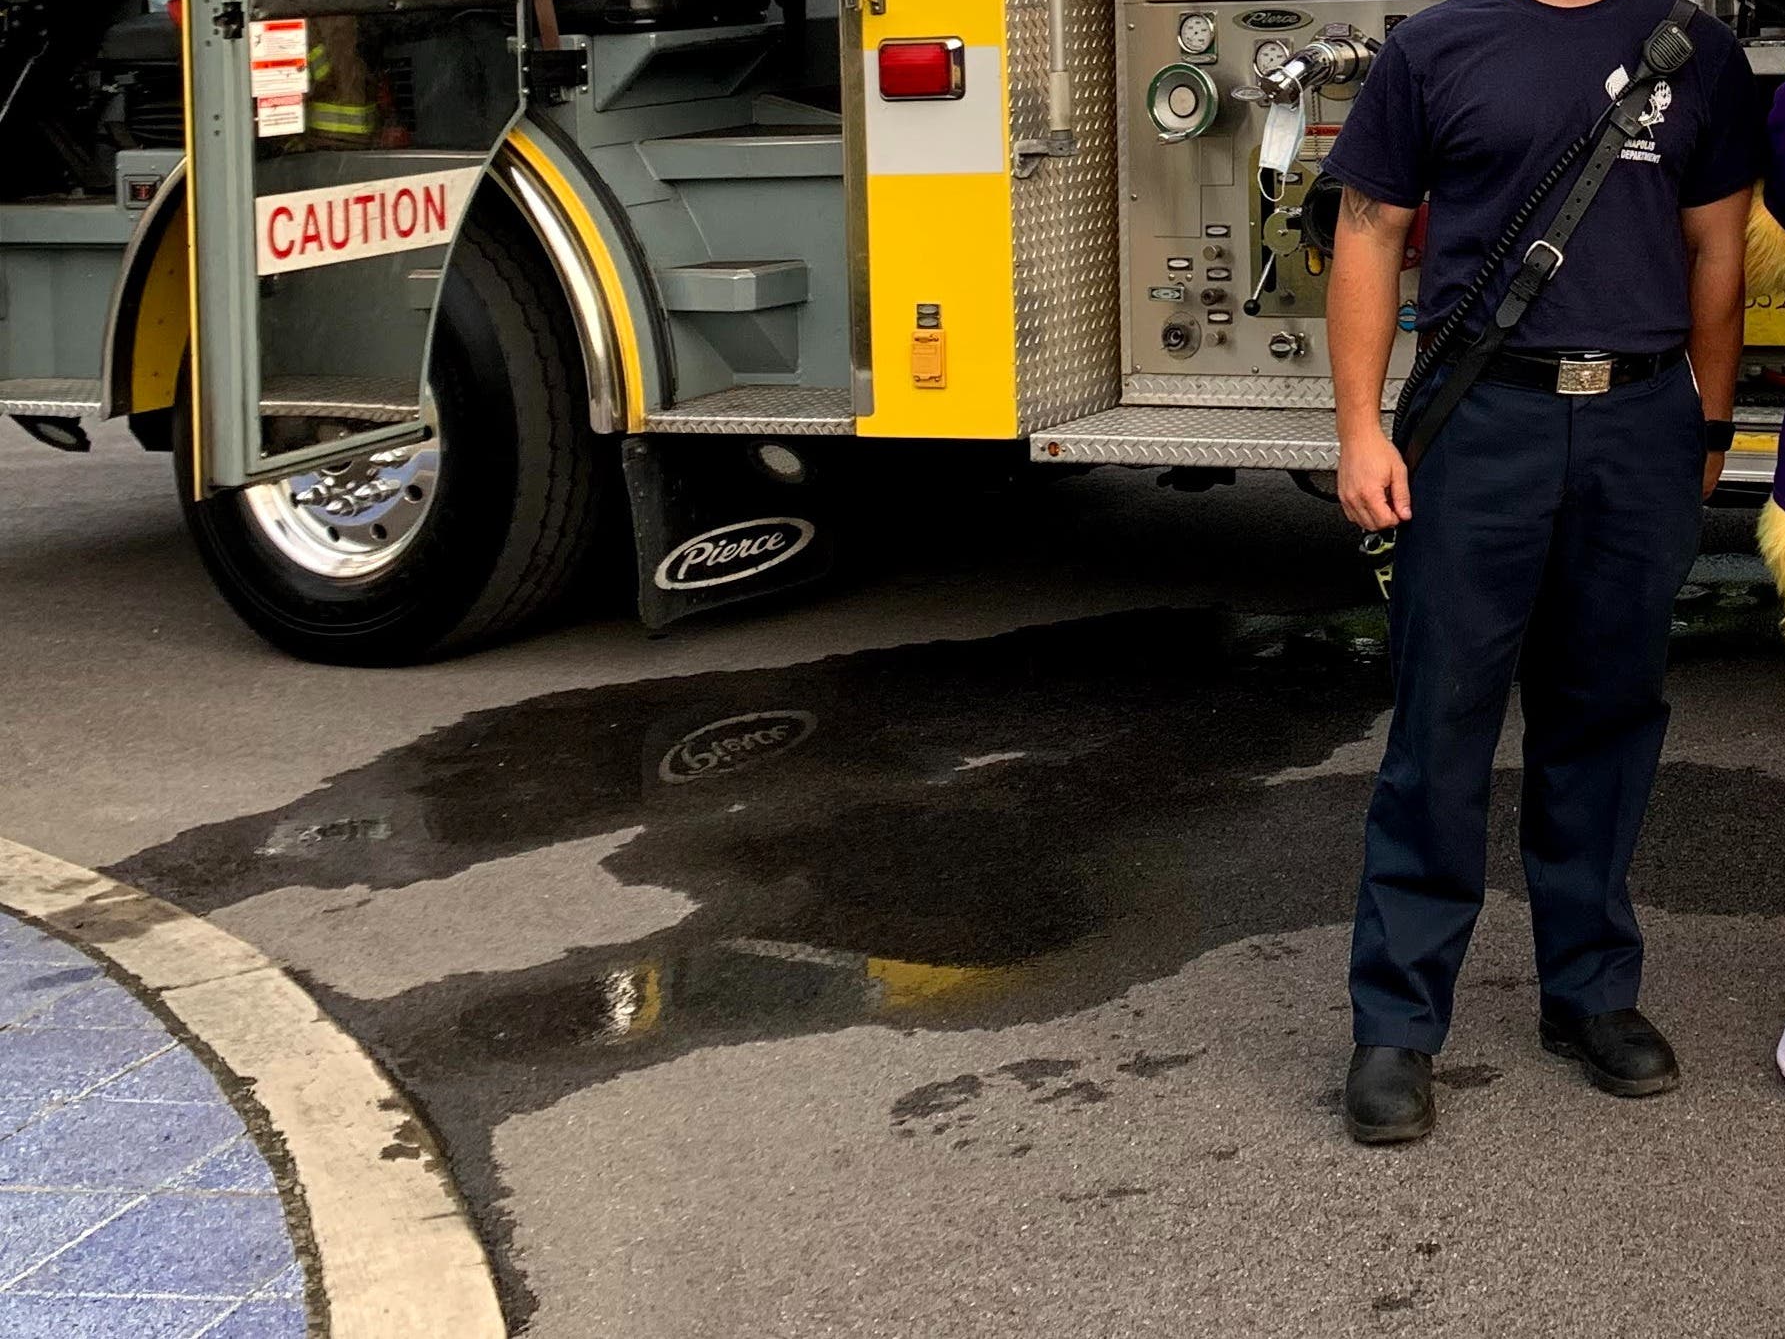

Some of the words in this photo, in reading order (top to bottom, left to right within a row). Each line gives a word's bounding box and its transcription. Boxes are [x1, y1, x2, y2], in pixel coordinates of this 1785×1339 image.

[1246, 12, 1299, 29] Pierce
[267, 183, 447, 260] CAUTION
[676, 531, 787, 580] Pierce
